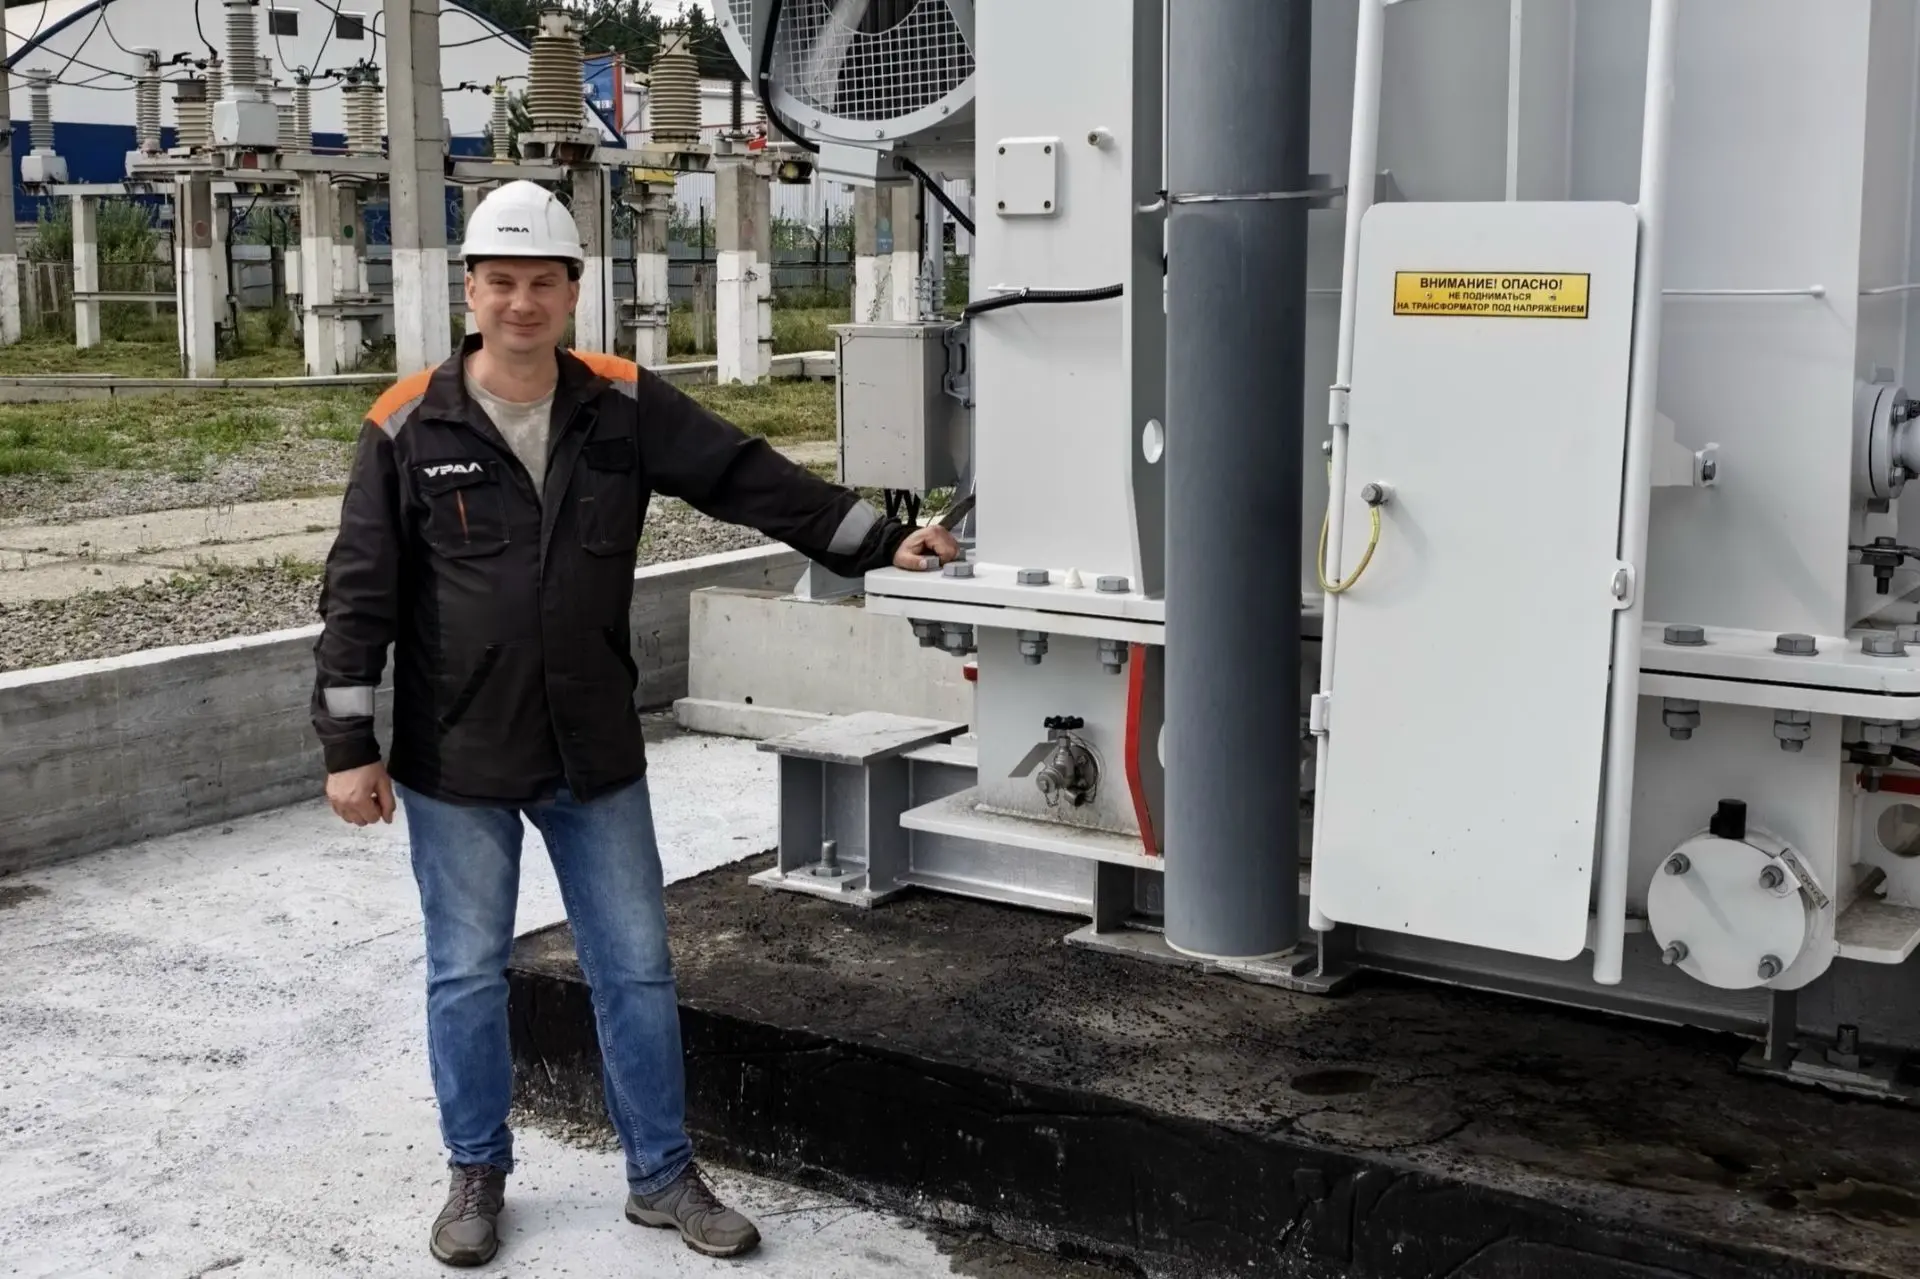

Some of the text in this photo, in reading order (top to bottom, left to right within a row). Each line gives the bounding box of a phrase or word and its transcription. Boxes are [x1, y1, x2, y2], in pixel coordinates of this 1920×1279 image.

[1420, 277, 1563, 290] ВНИМАНИЕ! ОПАСНО!
[1448, 291, 1532, 301] НЕ ПОДНИМАТЬСЯ
[1397, 302, 1585, 313] НА ТРАНСФОРМАТОР ПОД НАПРЯЖЕНИЕМ
[423, 462, 484, 478] УРАЛ
